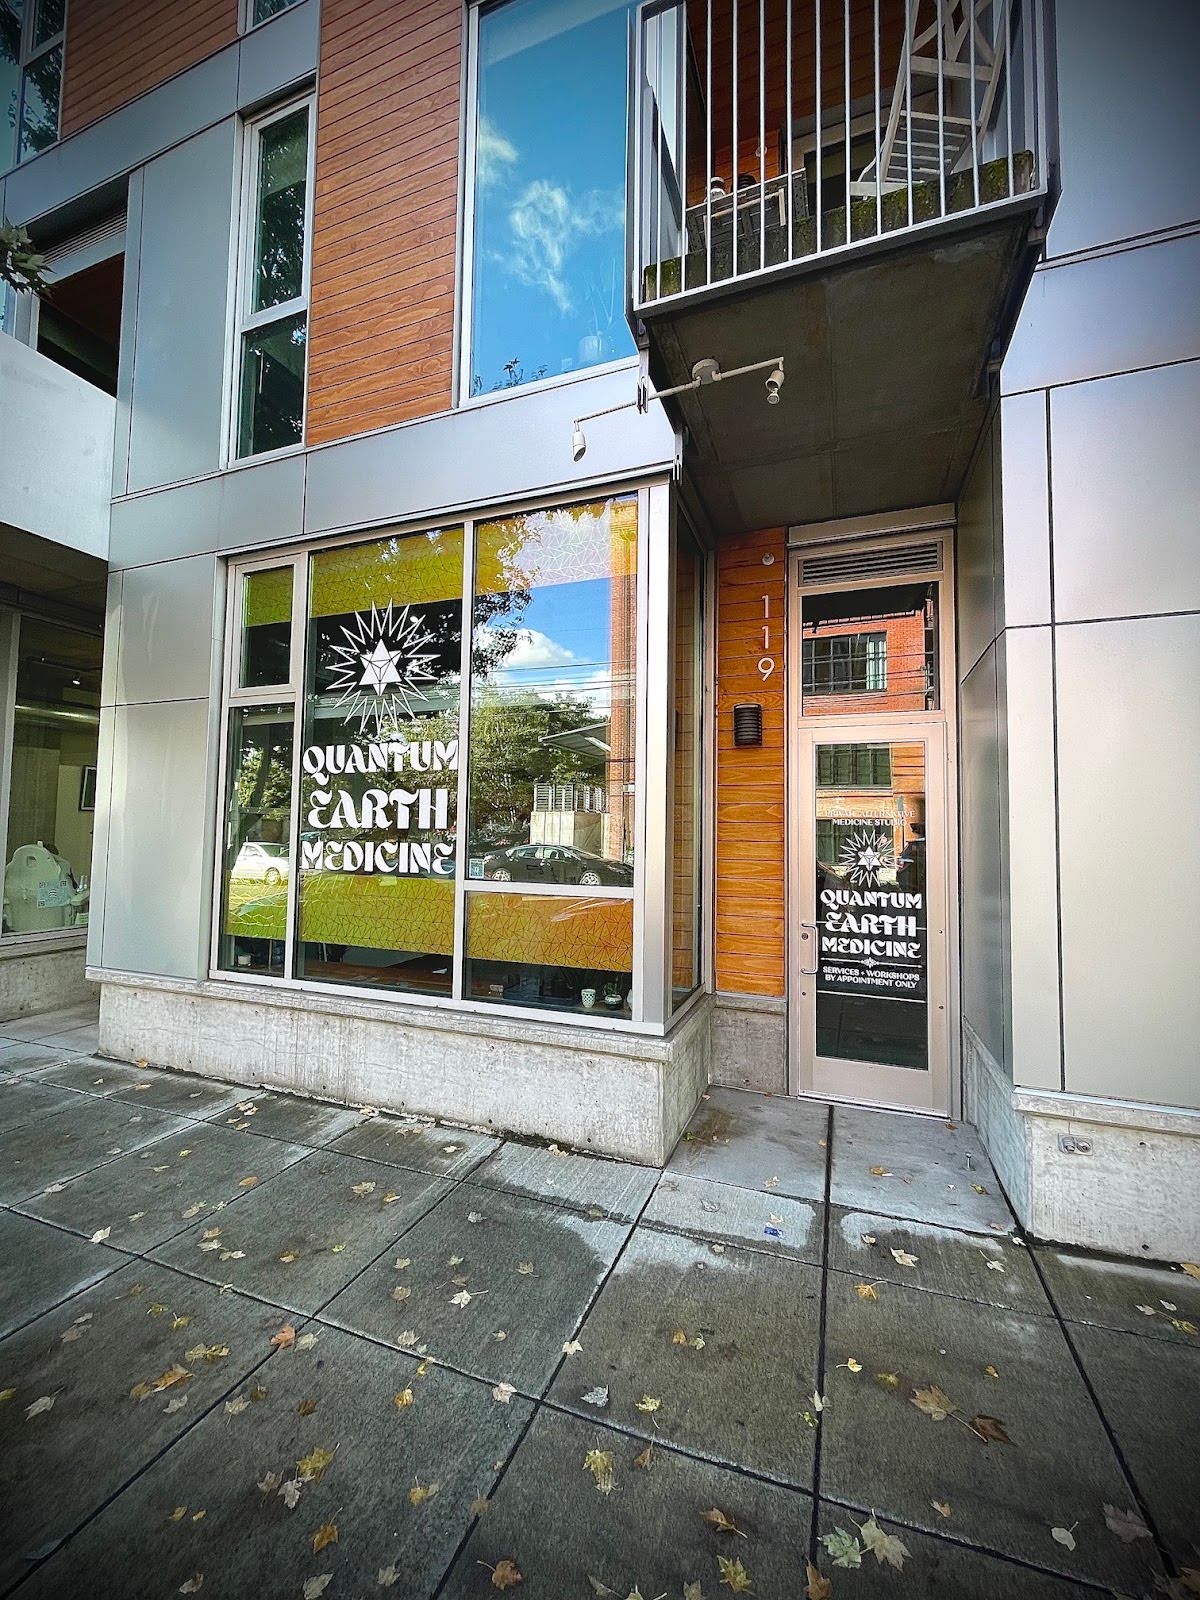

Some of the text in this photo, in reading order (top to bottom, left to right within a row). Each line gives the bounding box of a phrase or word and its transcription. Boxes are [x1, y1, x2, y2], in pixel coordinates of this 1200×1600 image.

[757, 594, 775, 682] 119
[302, 740, 459, 786] QUANTUM
[307, 788, 449, 830] EARTH
[860, 810, 915, 818] ALTERNATIVE
[832, 818, 908, 827] MEDICINE STUDIO
[301, 840, 455, 875] MEDICINE
[820, 889, 922, 911] QUANTUM
[825, 912, 917, 938] EARTH
[821, 936, 922, 959] MEDICINE
[822, 966, 860, 976] SERVICES
[866, 970, 920, 981] WORKSHOPS
[825, 974, 917, 989] BY APPOINTMENT ONLY
